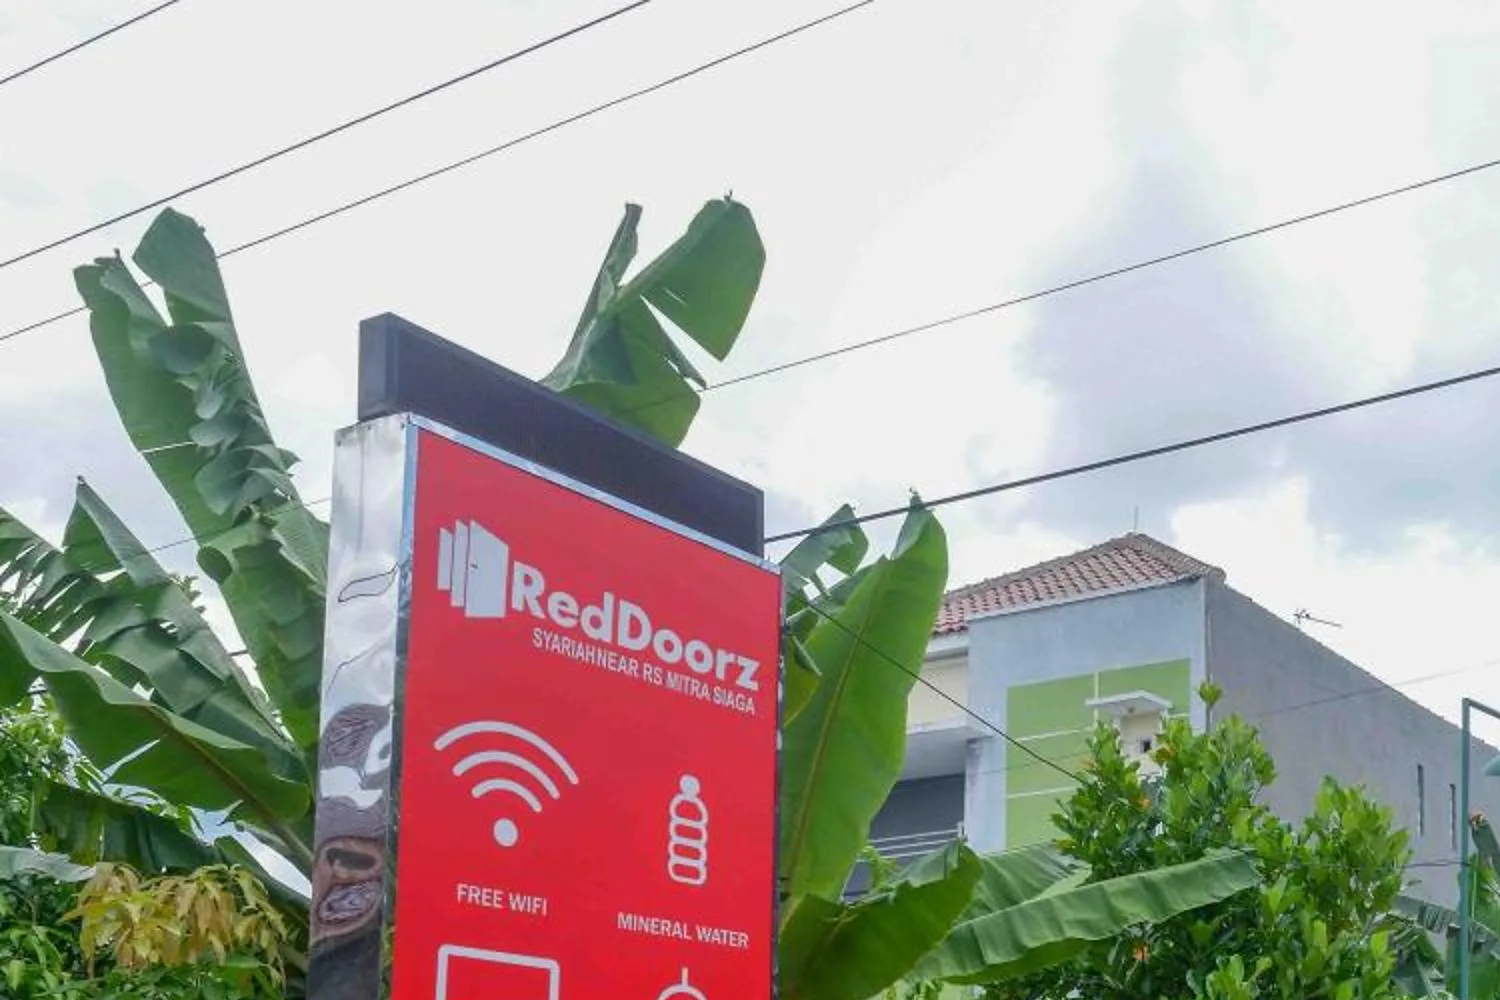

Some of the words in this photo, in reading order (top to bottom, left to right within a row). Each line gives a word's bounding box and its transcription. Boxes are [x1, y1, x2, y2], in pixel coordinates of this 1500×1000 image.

[511, 561, 761, 691] RedDoorz
[600, 648, 639, 677] NEAR
[643, 663, 663, 686] RS
[665, 671, 710, 701] MITRA
[712, 686, 756, 716] SIAGA
[456, 883, 503, 910] FREE
[508, 891, 548, 916] WIFI
[617, 912, 692, 941] MINERAL
[695, 923, 749, 949] WATER
